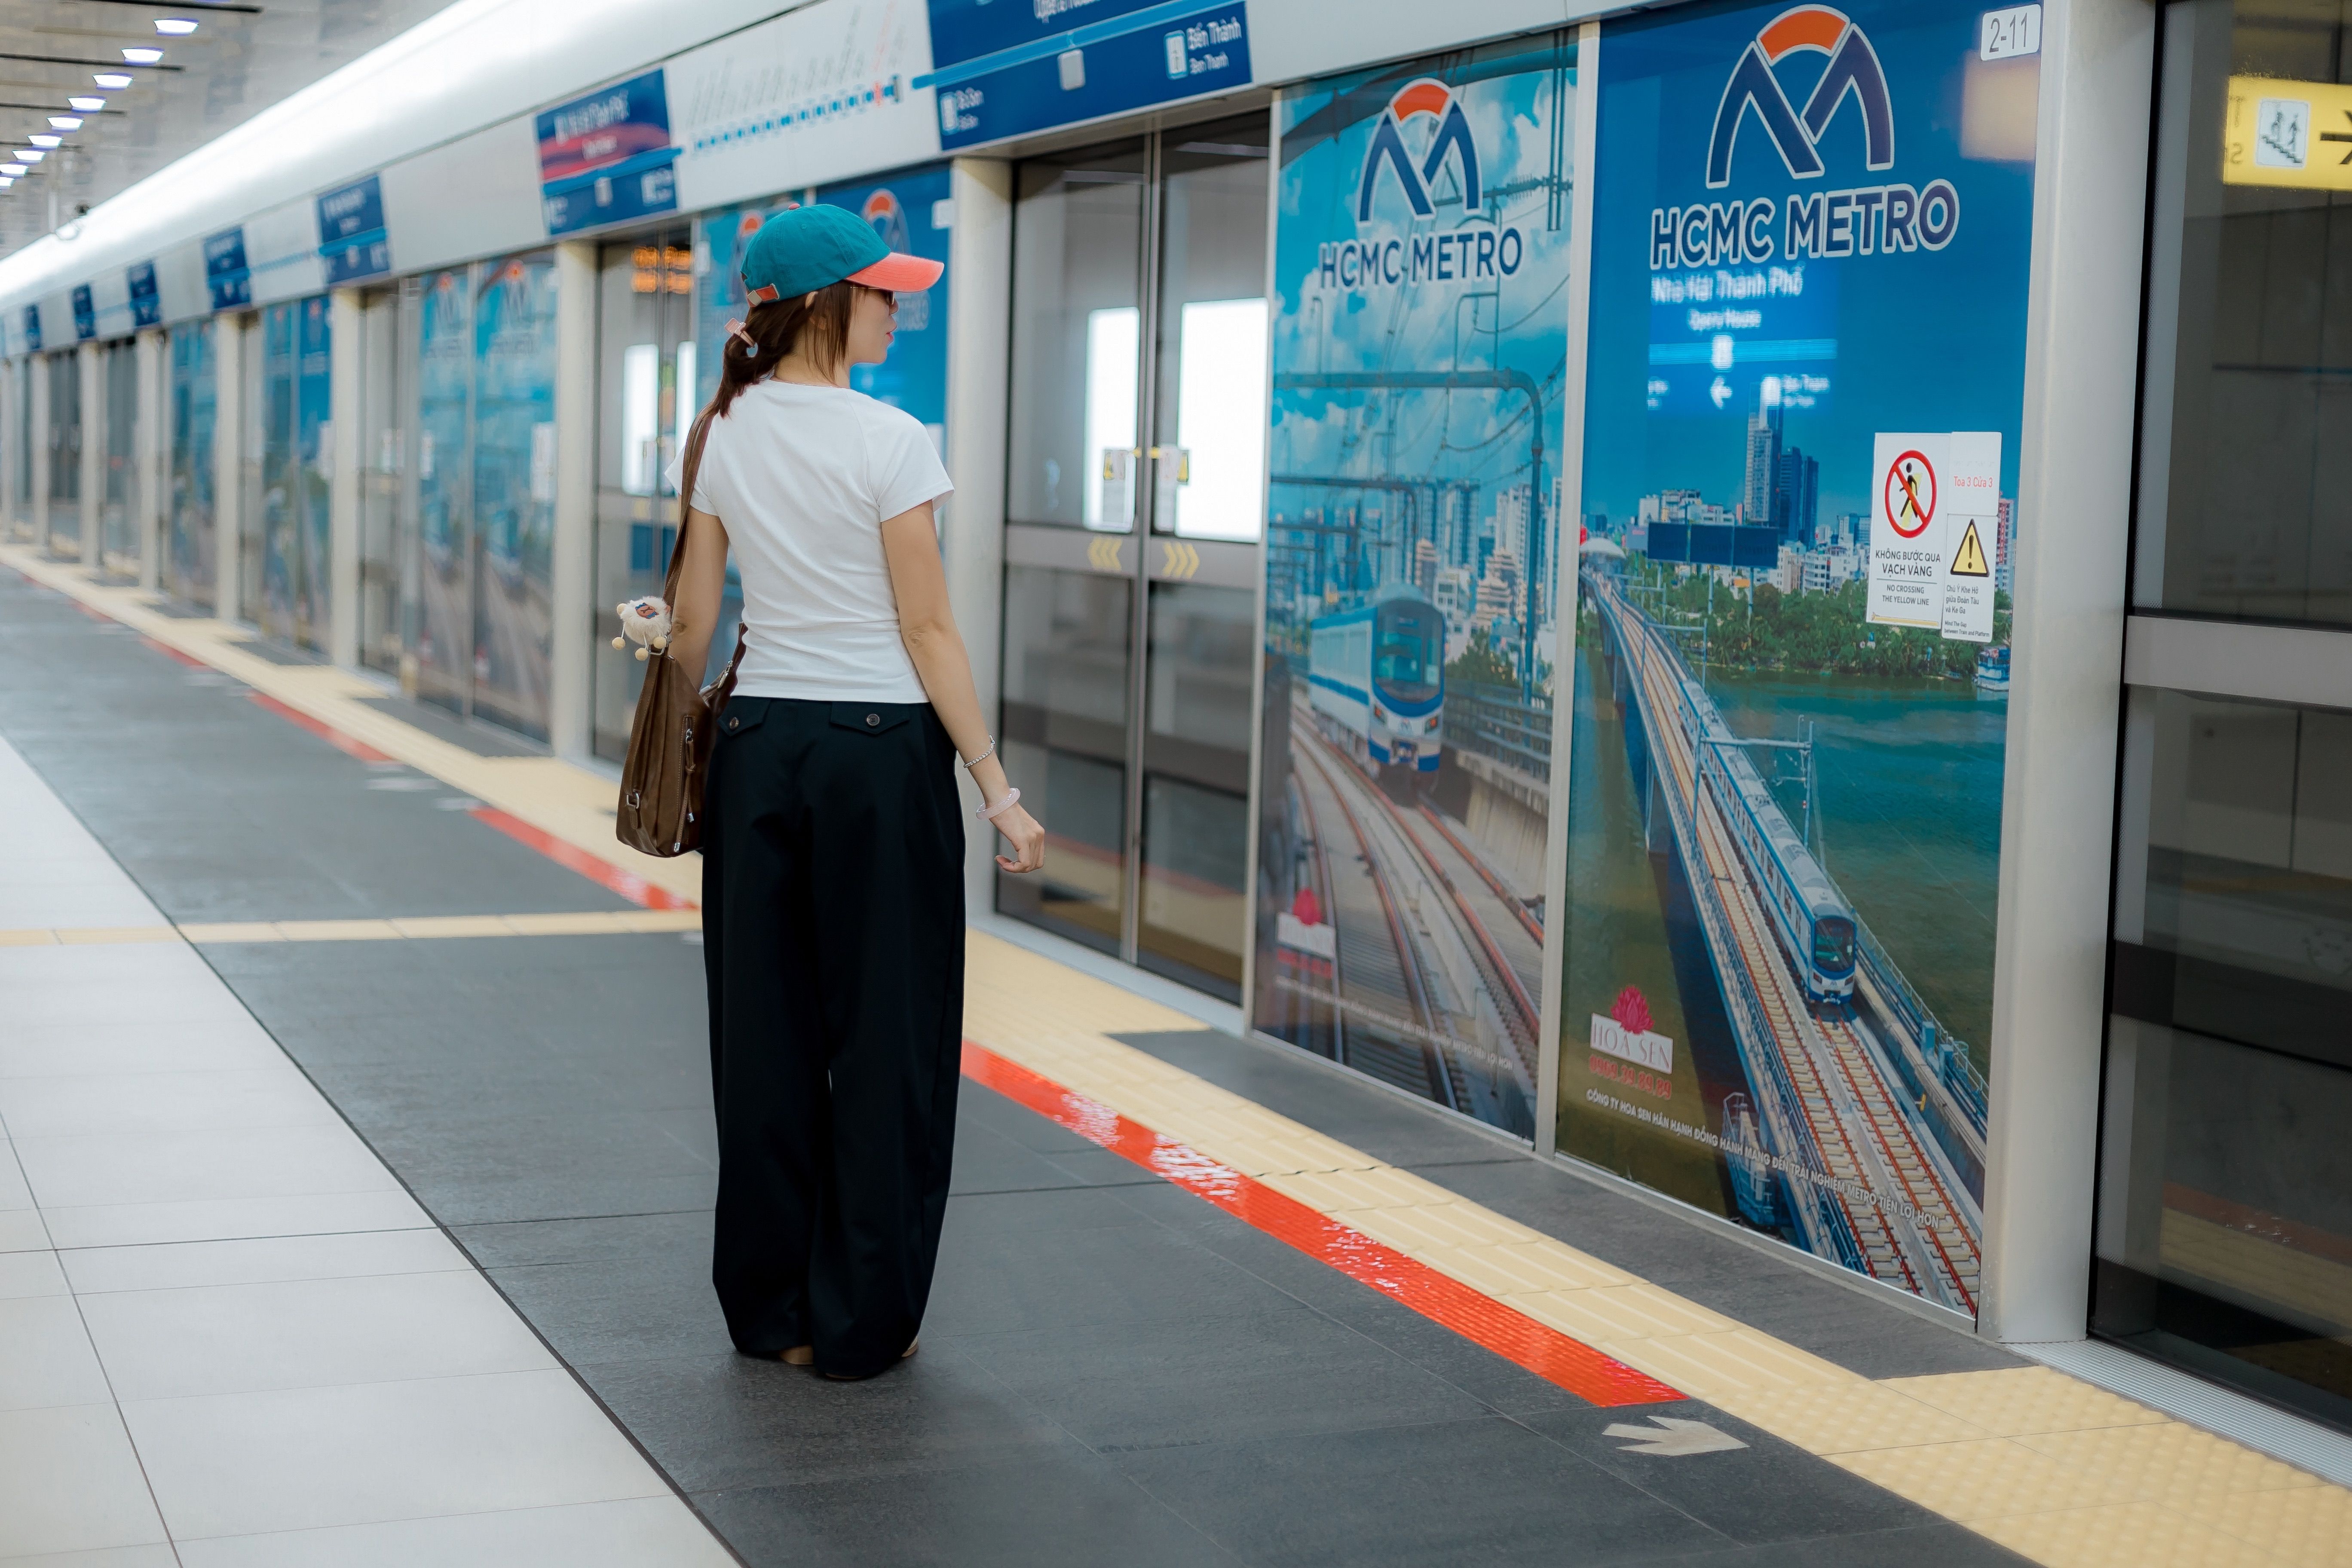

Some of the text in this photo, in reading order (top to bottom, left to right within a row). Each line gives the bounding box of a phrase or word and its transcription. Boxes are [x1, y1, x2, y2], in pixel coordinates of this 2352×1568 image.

[1989, 12, 2027, 52] 2-11
[1650, 178, 1960, 270] HCMC METRO
[1319, 227, 1523, 289] HCMC METRO
[1954, 476, 1993, 487] Toa 3 Cửa 3
[1876, 548, 1940, 562] KHÔNG BƯỚC QUA
[1883, 562, 1932, 577] VẠCH VÀNG
[1896, 585, 1924, 594] CROSSING
[1957, 583, 1960, 592] Ý
[1894, 596, 1916, 604] YELLOW
[1593, 1023, 1670, 1068] HOA SEN
[1586, 1088, 1610, 1107] CÔNG
[1610, 1097, 1619, 1110] TY
[1620, 1100, 1637, 1117] HOA
[1637, 1107, 1652, 1123] SEN
[1670, 1119, 1693, 1137] HẠNH
[1744, 1146, 1770, 1165] MANG
[1811, 1170, 1846, 1194] NGHIỆM
[1847, 1184, 1877, 1206] METRO
[1900, 1205, 1915, 1221] LỢI
[1917, 1210, 1939, 1229] HƠN
